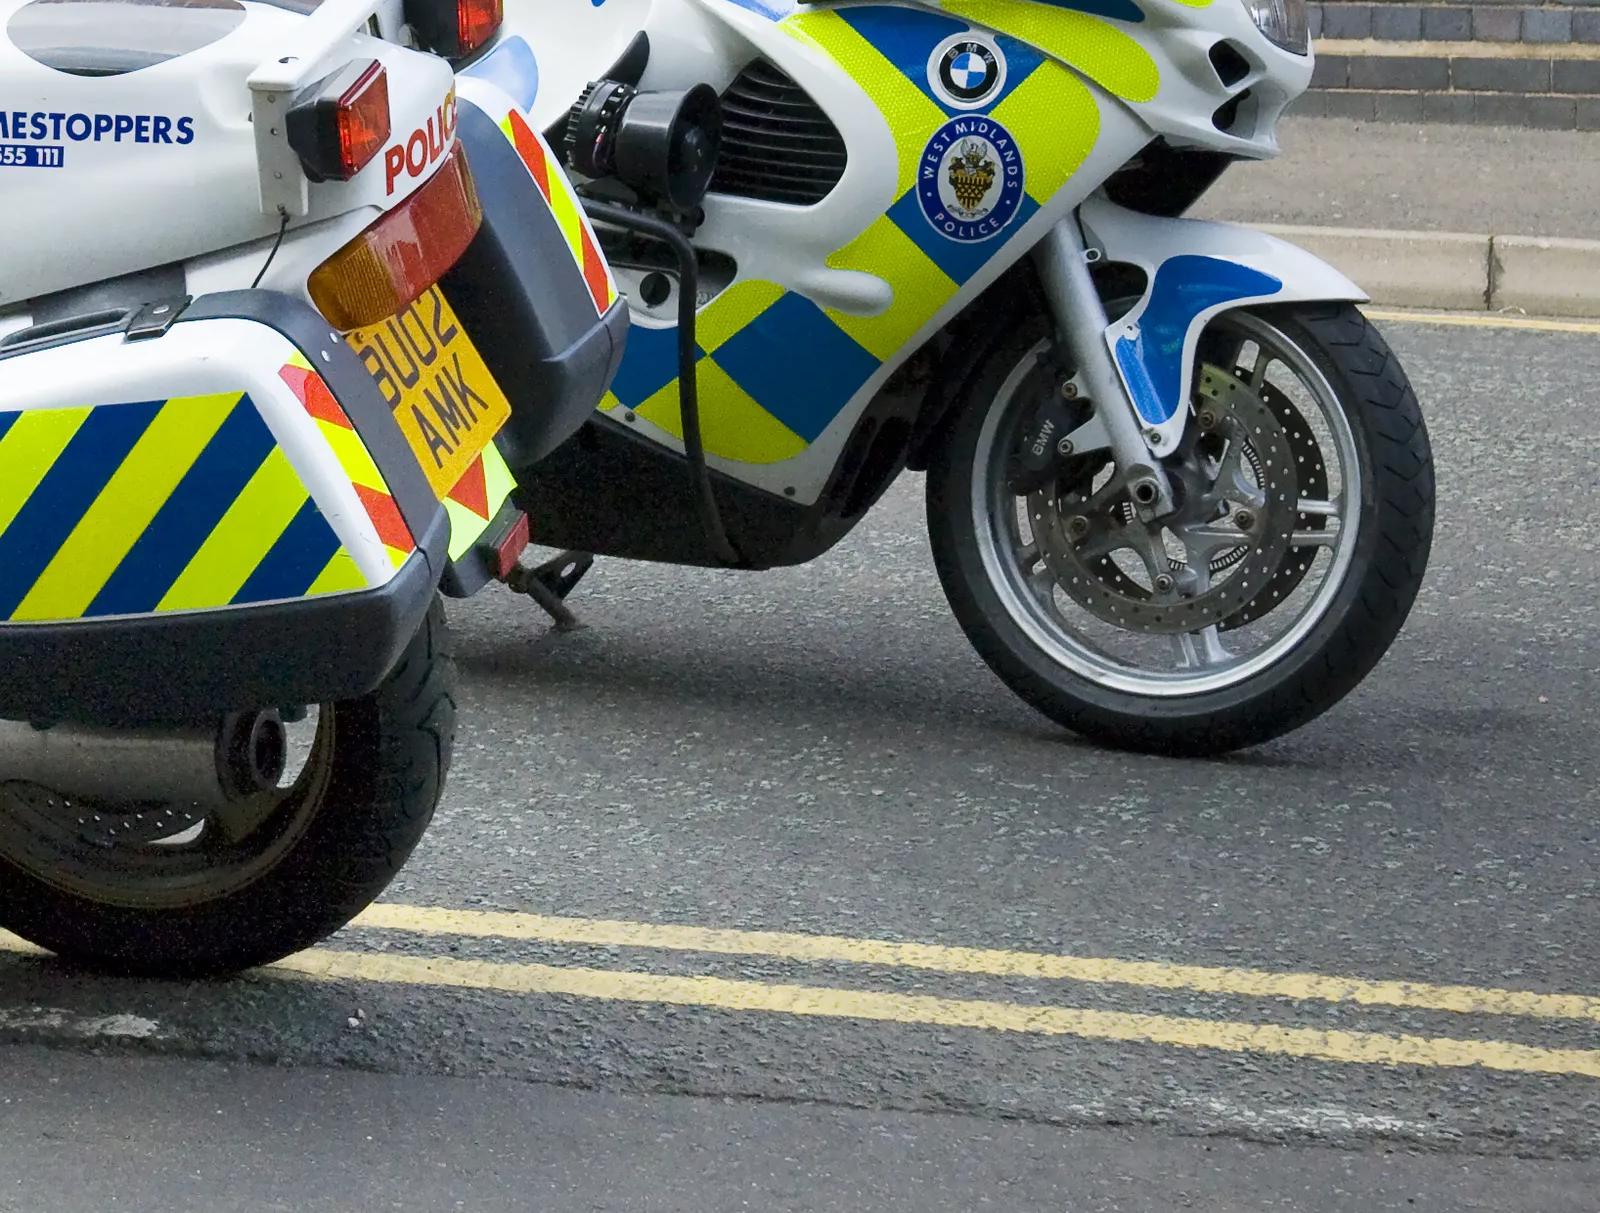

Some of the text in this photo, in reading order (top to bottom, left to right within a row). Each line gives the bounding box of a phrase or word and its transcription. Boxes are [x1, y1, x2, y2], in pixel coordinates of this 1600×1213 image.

[947, 42, 995, 64] BMW
[36, 148, 59, 165] 111
[923, 121, 1018, 188] WEST MIDLANDS
[934, 212, 999, 237] POLICE
[411, 352, 489, 469] AMK
[1031, 418, 1055, 456] BMW
